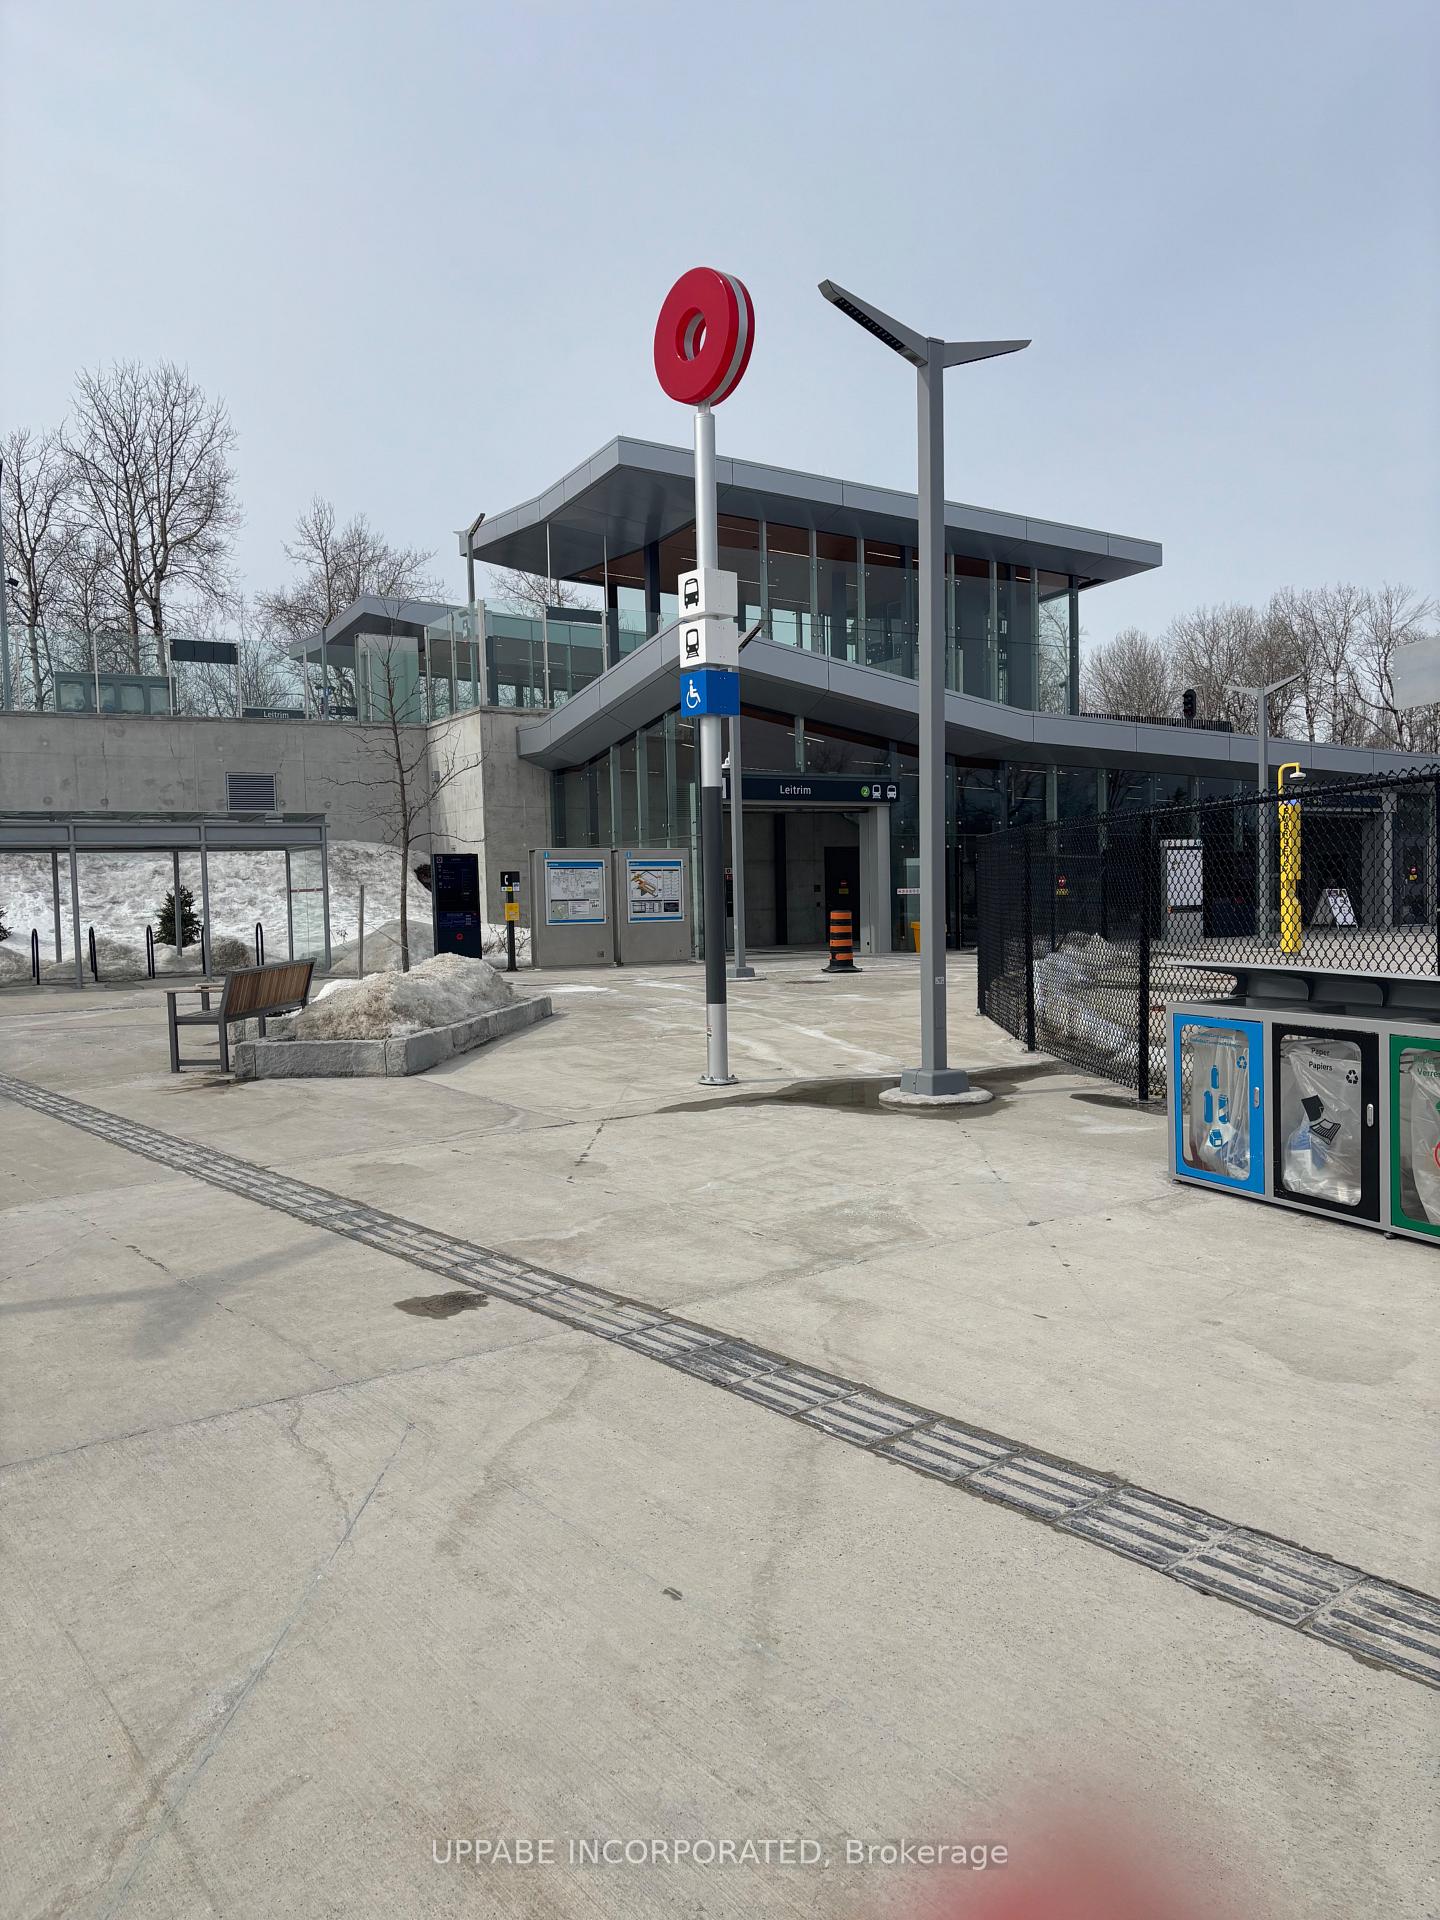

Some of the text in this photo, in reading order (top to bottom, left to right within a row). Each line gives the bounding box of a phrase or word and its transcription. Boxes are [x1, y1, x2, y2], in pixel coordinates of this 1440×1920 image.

[263, 710, 289, 719] Leitrim
[779, 784, 812, 795] Leitrim
[1311, 1047, 1330, 1057] Paper
[1308, 1060, 1333, 1072] Papiers
